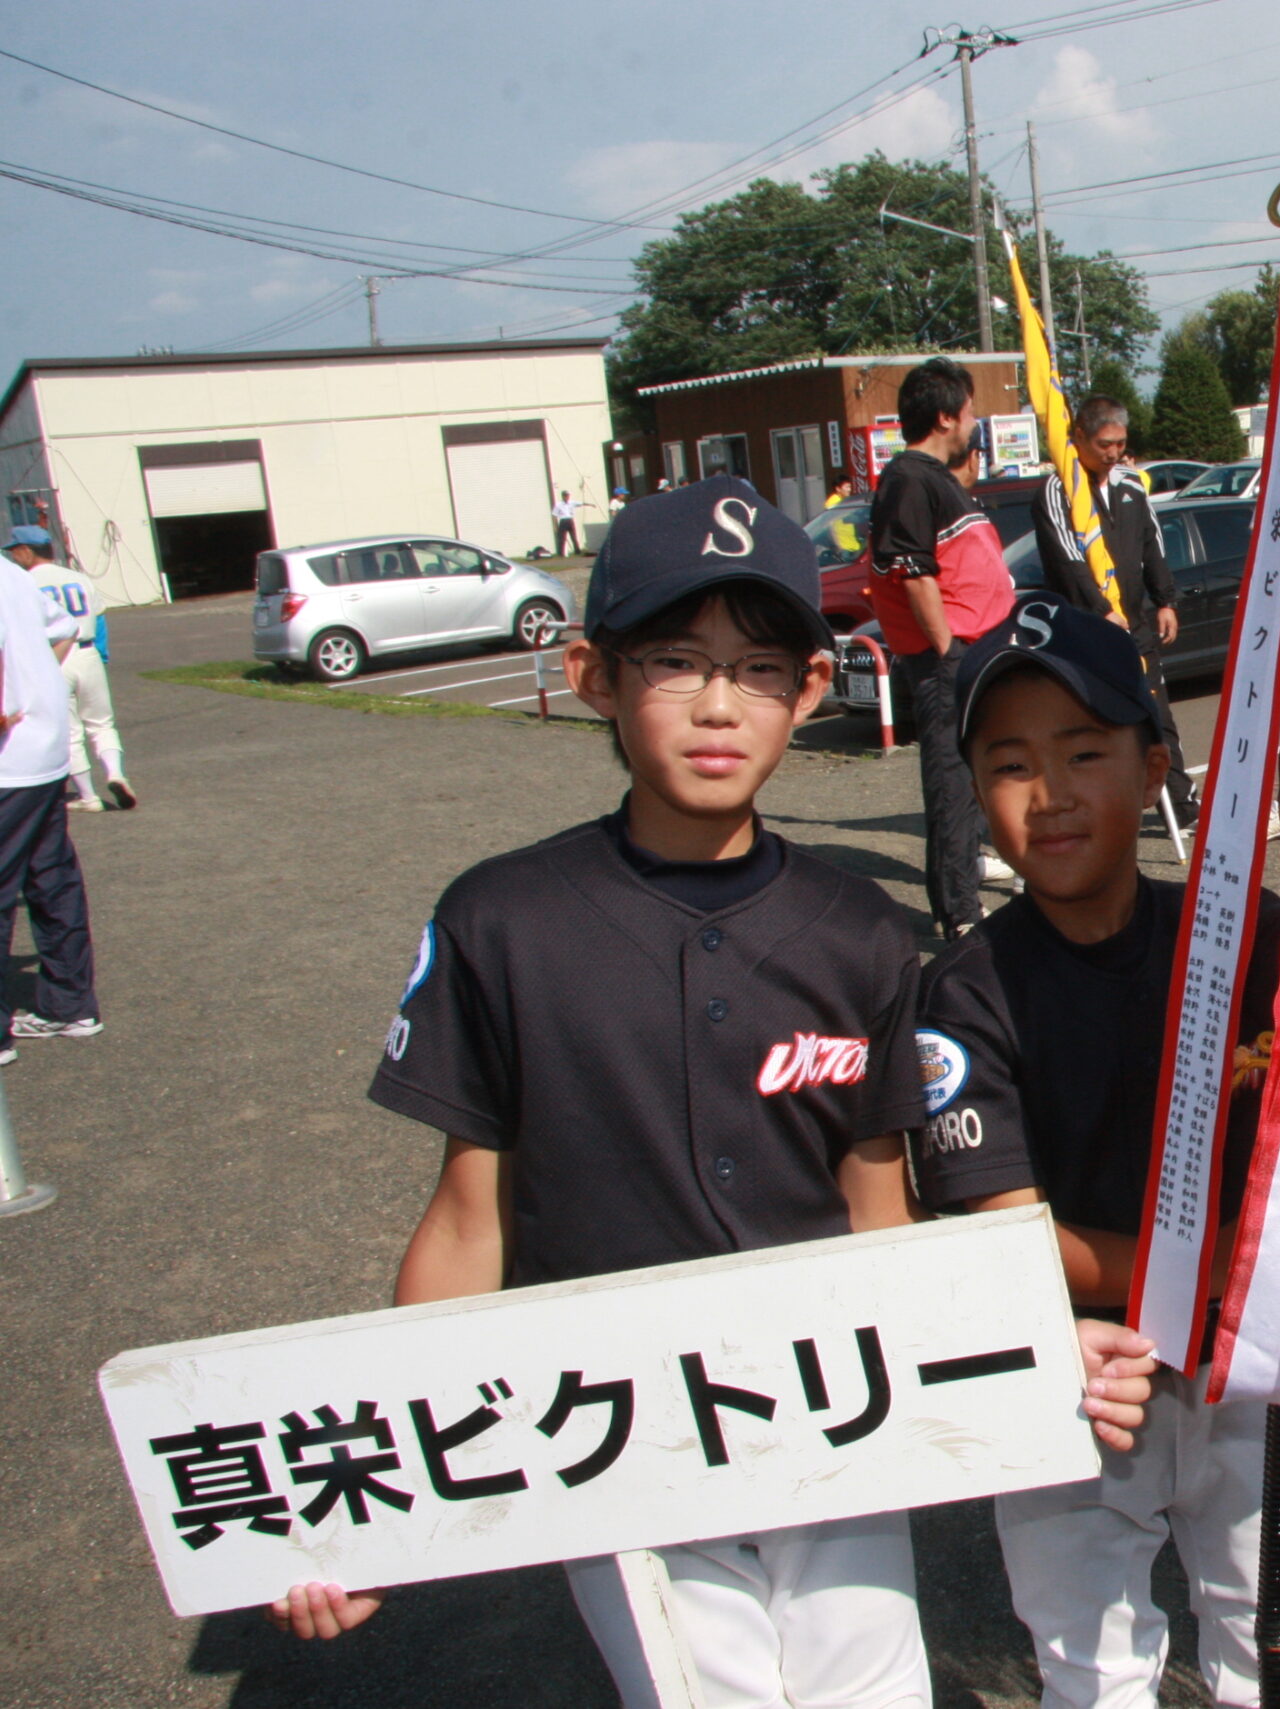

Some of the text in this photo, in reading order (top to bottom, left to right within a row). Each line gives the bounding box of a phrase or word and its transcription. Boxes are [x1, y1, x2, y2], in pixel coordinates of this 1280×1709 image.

[701, 496, 758, 558] S
[1009, 601, 1060, 650] S
[149, 1323, 1039, 1552] 真栄ビクトリー
